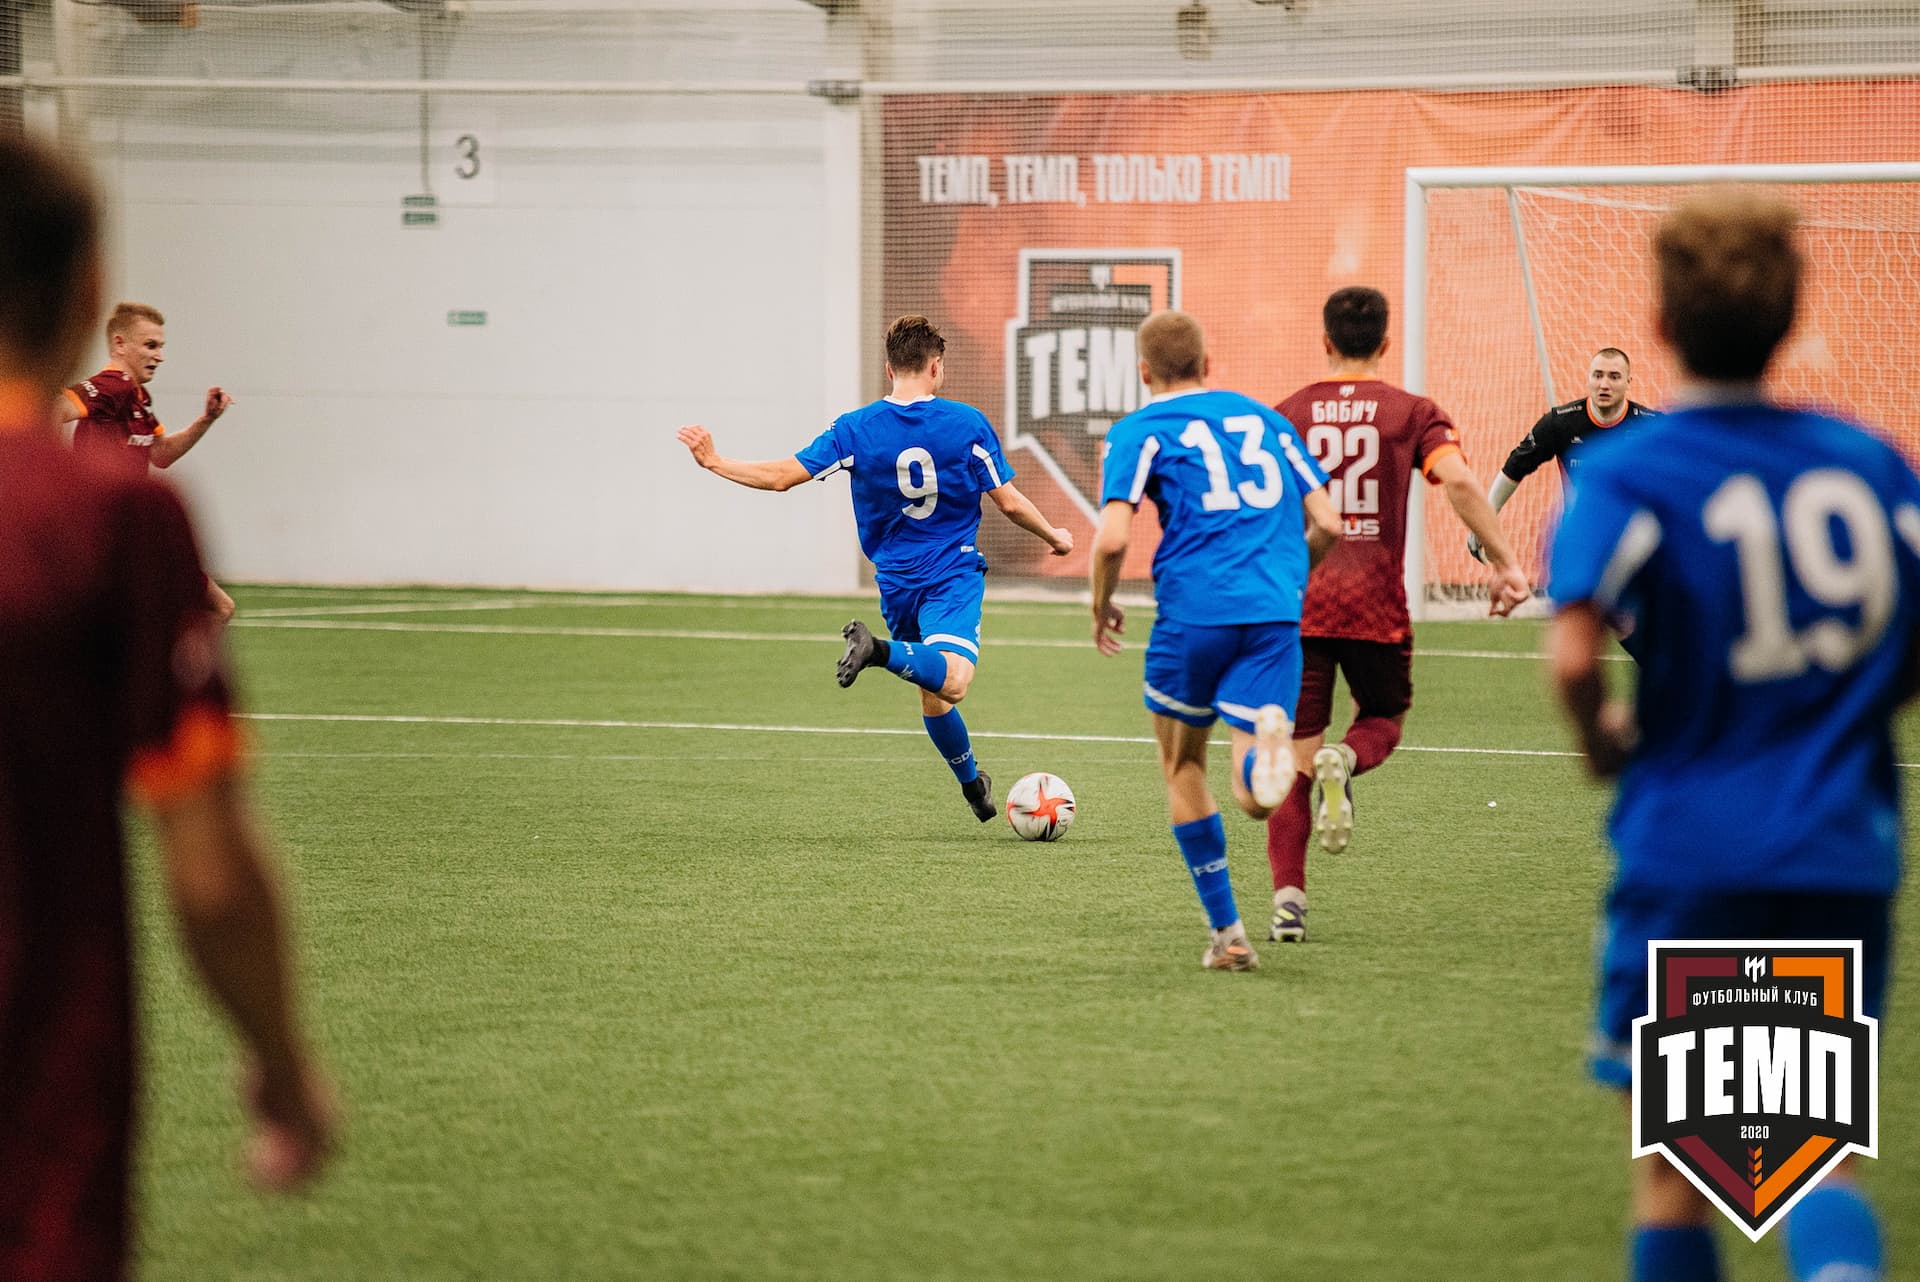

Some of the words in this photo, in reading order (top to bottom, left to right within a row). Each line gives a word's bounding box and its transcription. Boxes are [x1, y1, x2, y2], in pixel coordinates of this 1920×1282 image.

[454, 133, 481, 180] 3
[918, 155, 999, 209] ТЕМП,
[1005, 155, 1087, 209] ТЕМП,
[1094, 154, 1202, 202] ТОЛЬКО
[1210, 154, 1291, 202] ТЕМП!
[1025, 326, 1151, 420] ТЕМ
[1311, 400, 1378, 423] БАБИЧ
[895, 446, 938, 520] 9
[1179, 414, 1284, 511] 13
[1306, 424, 1380, 514] 22
[1703, 466, 1899, 682] 19
